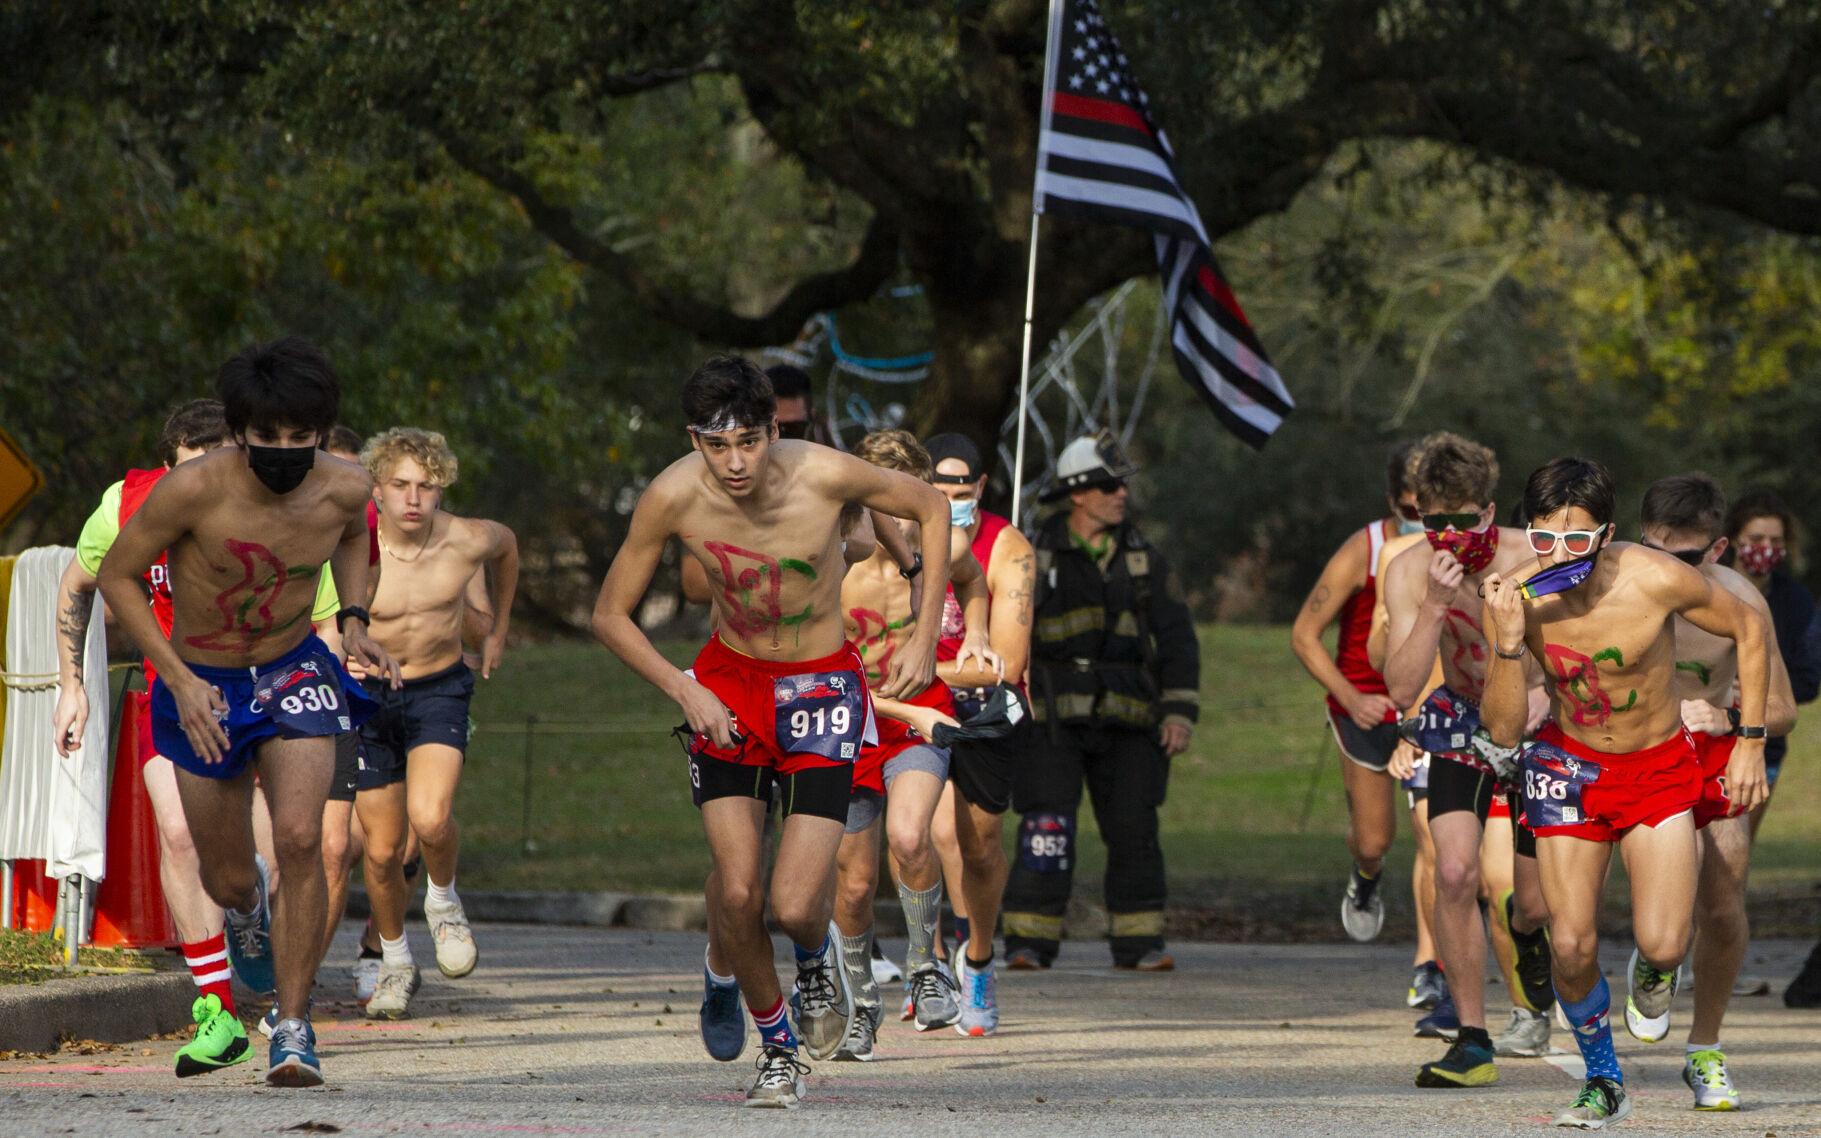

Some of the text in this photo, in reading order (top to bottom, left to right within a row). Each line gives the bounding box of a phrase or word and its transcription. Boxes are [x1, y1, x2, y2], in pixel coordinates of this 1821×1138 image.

[281, 685, 338, 714] 930
[791, 706, 850, 738] 919
[1031, 834, 1067, 857] 952
